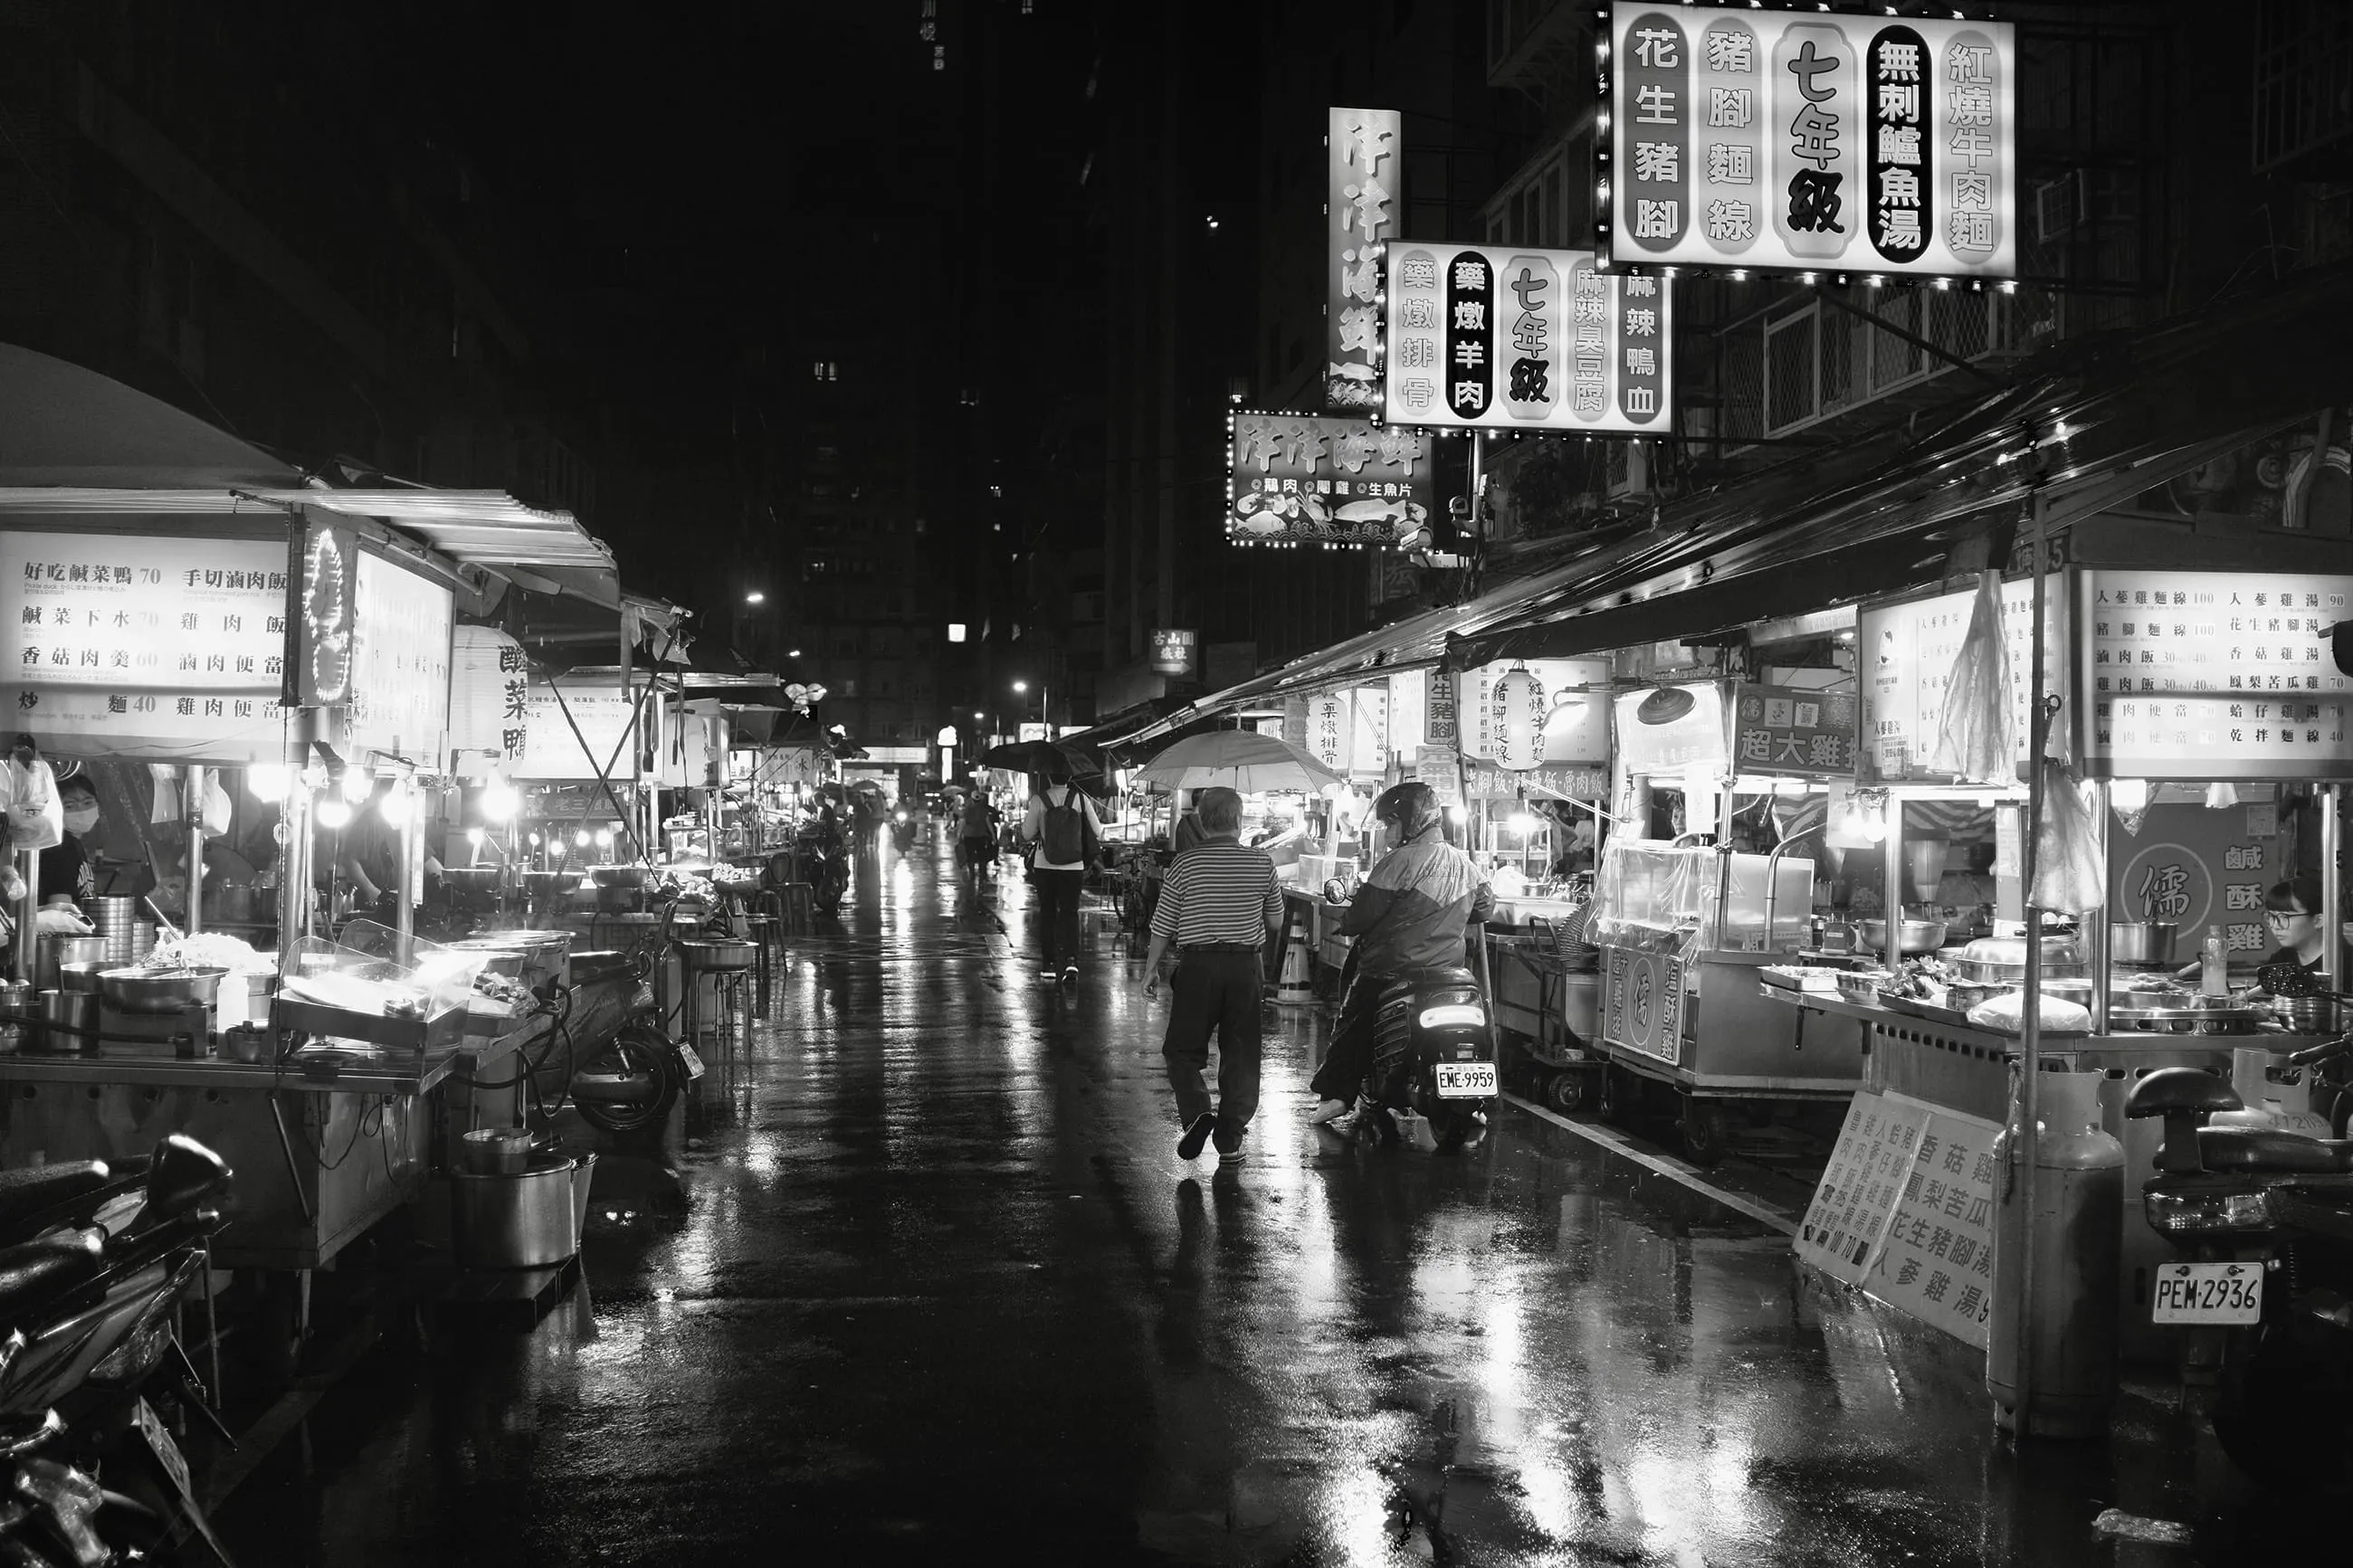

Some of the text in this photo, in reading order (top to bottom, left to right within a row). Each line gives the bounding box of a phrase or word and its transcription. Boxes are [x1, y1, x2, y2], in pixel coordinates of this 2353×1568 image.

[1634, 27, 1680, 240] 花生豬腳
[1707, 30, 1754, 242] 豬腳麵線
[1787, 40, 1845, 234] 七年級
[1877, 40, 1921, 251] 無刺鱸魚湯
[1948, 43, 1995, 253] 紅燒牛肉麵
[1403, 259, 1434, 407] 藥燉排骨
[1454, 261, 1485, 409] 藥燉羊肉
[1510, 267, 1550, 404] 七年級
[1574, 268, 1606, 412] 麻辣臭豆腐
[1625, 275, 1656, 414] 麻辣鴨血
[1368, 482, 1413, 498] 生魚片
[24, 562, 161, 585] 好吃鹹菜鴨 70
[2194, 593, 2215, 604] 100
[2329, 594, 2344, 606] 90
[22, 605, 159, 627] 鹹菜下水 70
[181, 613, 286, 634] 雞肉飯
[2229, 617, 2319, 632] 花生豬腳湯
[2097, 622, 2215, 636] 豬腳麵線 100
[21, 646, 158, 669] 香菇肉羹 60
[179, 653, 284, 675] 滷肉便當
[2096, 650, 2154, 663] 滷肉飯
[2230, 646, 2319, 660] 香菇雞湯
[2097, 677, 2154, 691] 雞肉飯
[2229, 675, 2344, 689] 鳳梨苦瓜雞 70
[133, 696, 157, 714] 40
[176, 697, 281, 719] 雞肉便當
[2097, 703, 2187, 717] 雞肉便當
[2329, 706, 2344, 717] 70
[2230, 728, 2344, 743] 乾拌麵線 40
[1917, 1134, 1991, 1186] 香菇雞
